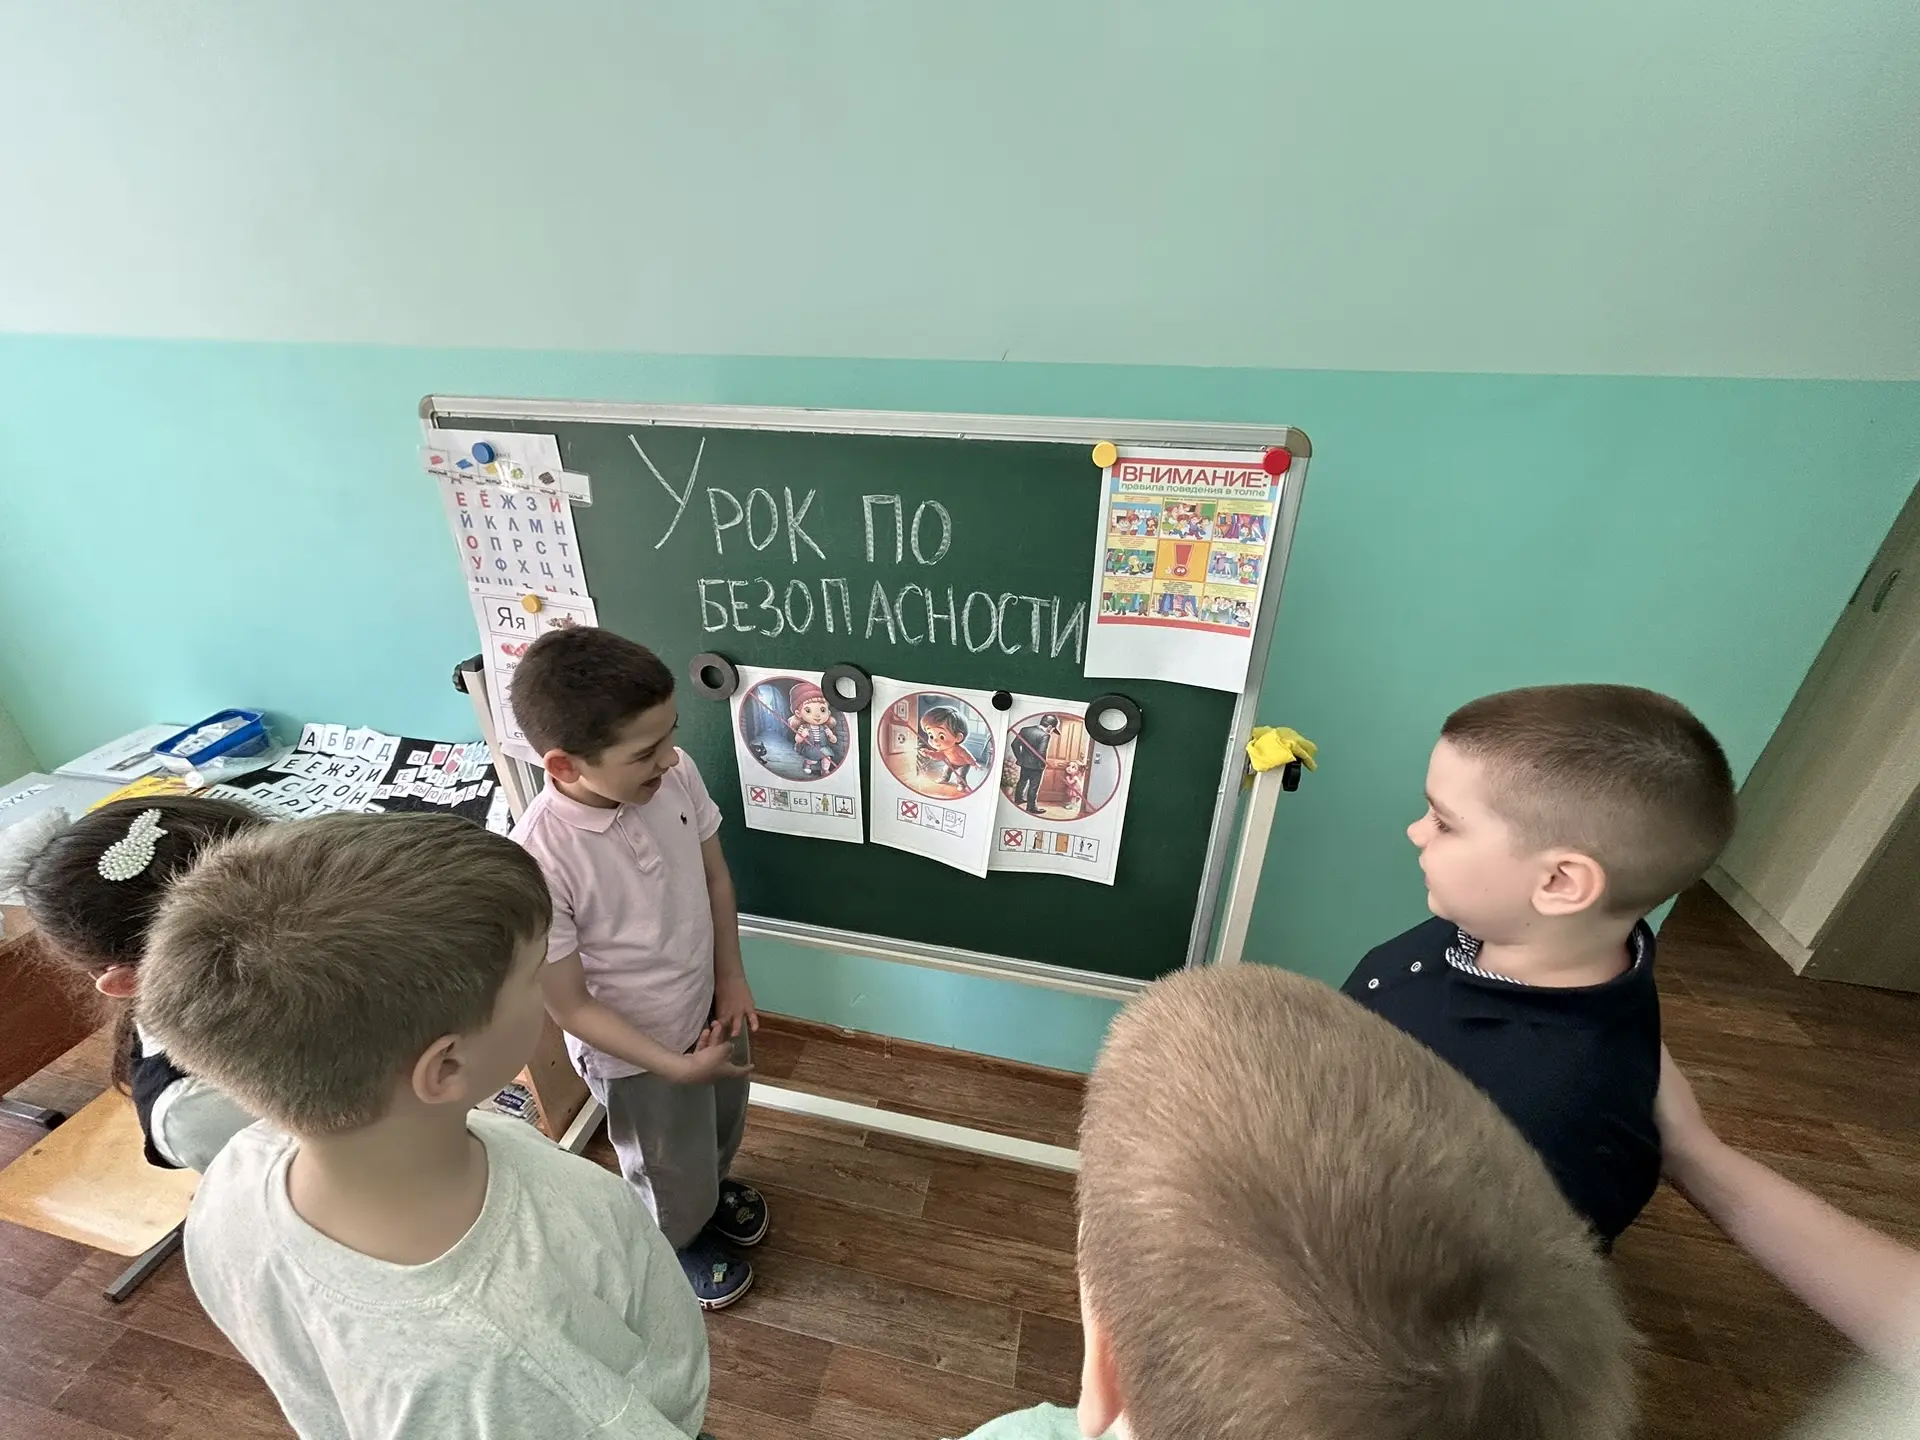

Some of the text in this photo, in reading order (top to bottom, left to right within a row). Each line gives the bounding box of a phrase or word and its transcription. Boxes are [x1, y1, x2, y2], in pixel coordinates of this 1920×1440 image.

[1122, 465, 1269, 488] ВНИМАНИЕ:
[628, 434, 952, 566] УРОК ПО
[1121, 482, 1164, 492] правила
[1166, 484, 1223, 496] поведения
[1234, 488, 1266, 497] толпе
[456, 492, 468, 507] Е
[500, 494, 517, 510] Ж
[526, 496, 537, 511] З
[549, 497, 562, 513] И
[460, 510, 566, 536] Й К Л М Н
[466, 535, 568, 557] О П Р С Т
[471, 556, 575, 578] У Ф Х Ц Ч
[697, 576, 1086, 664] БЕЗОПАСНОСТИ
[304, 732, 392, 761] А Б В Г Д
[283, 759, 382, 782] Е Е Ж З И
[252, 788, 273, 798] П
[281, 783, 367, 804] С Л О Н
[793, 797, 808, 807] БЕЗ
